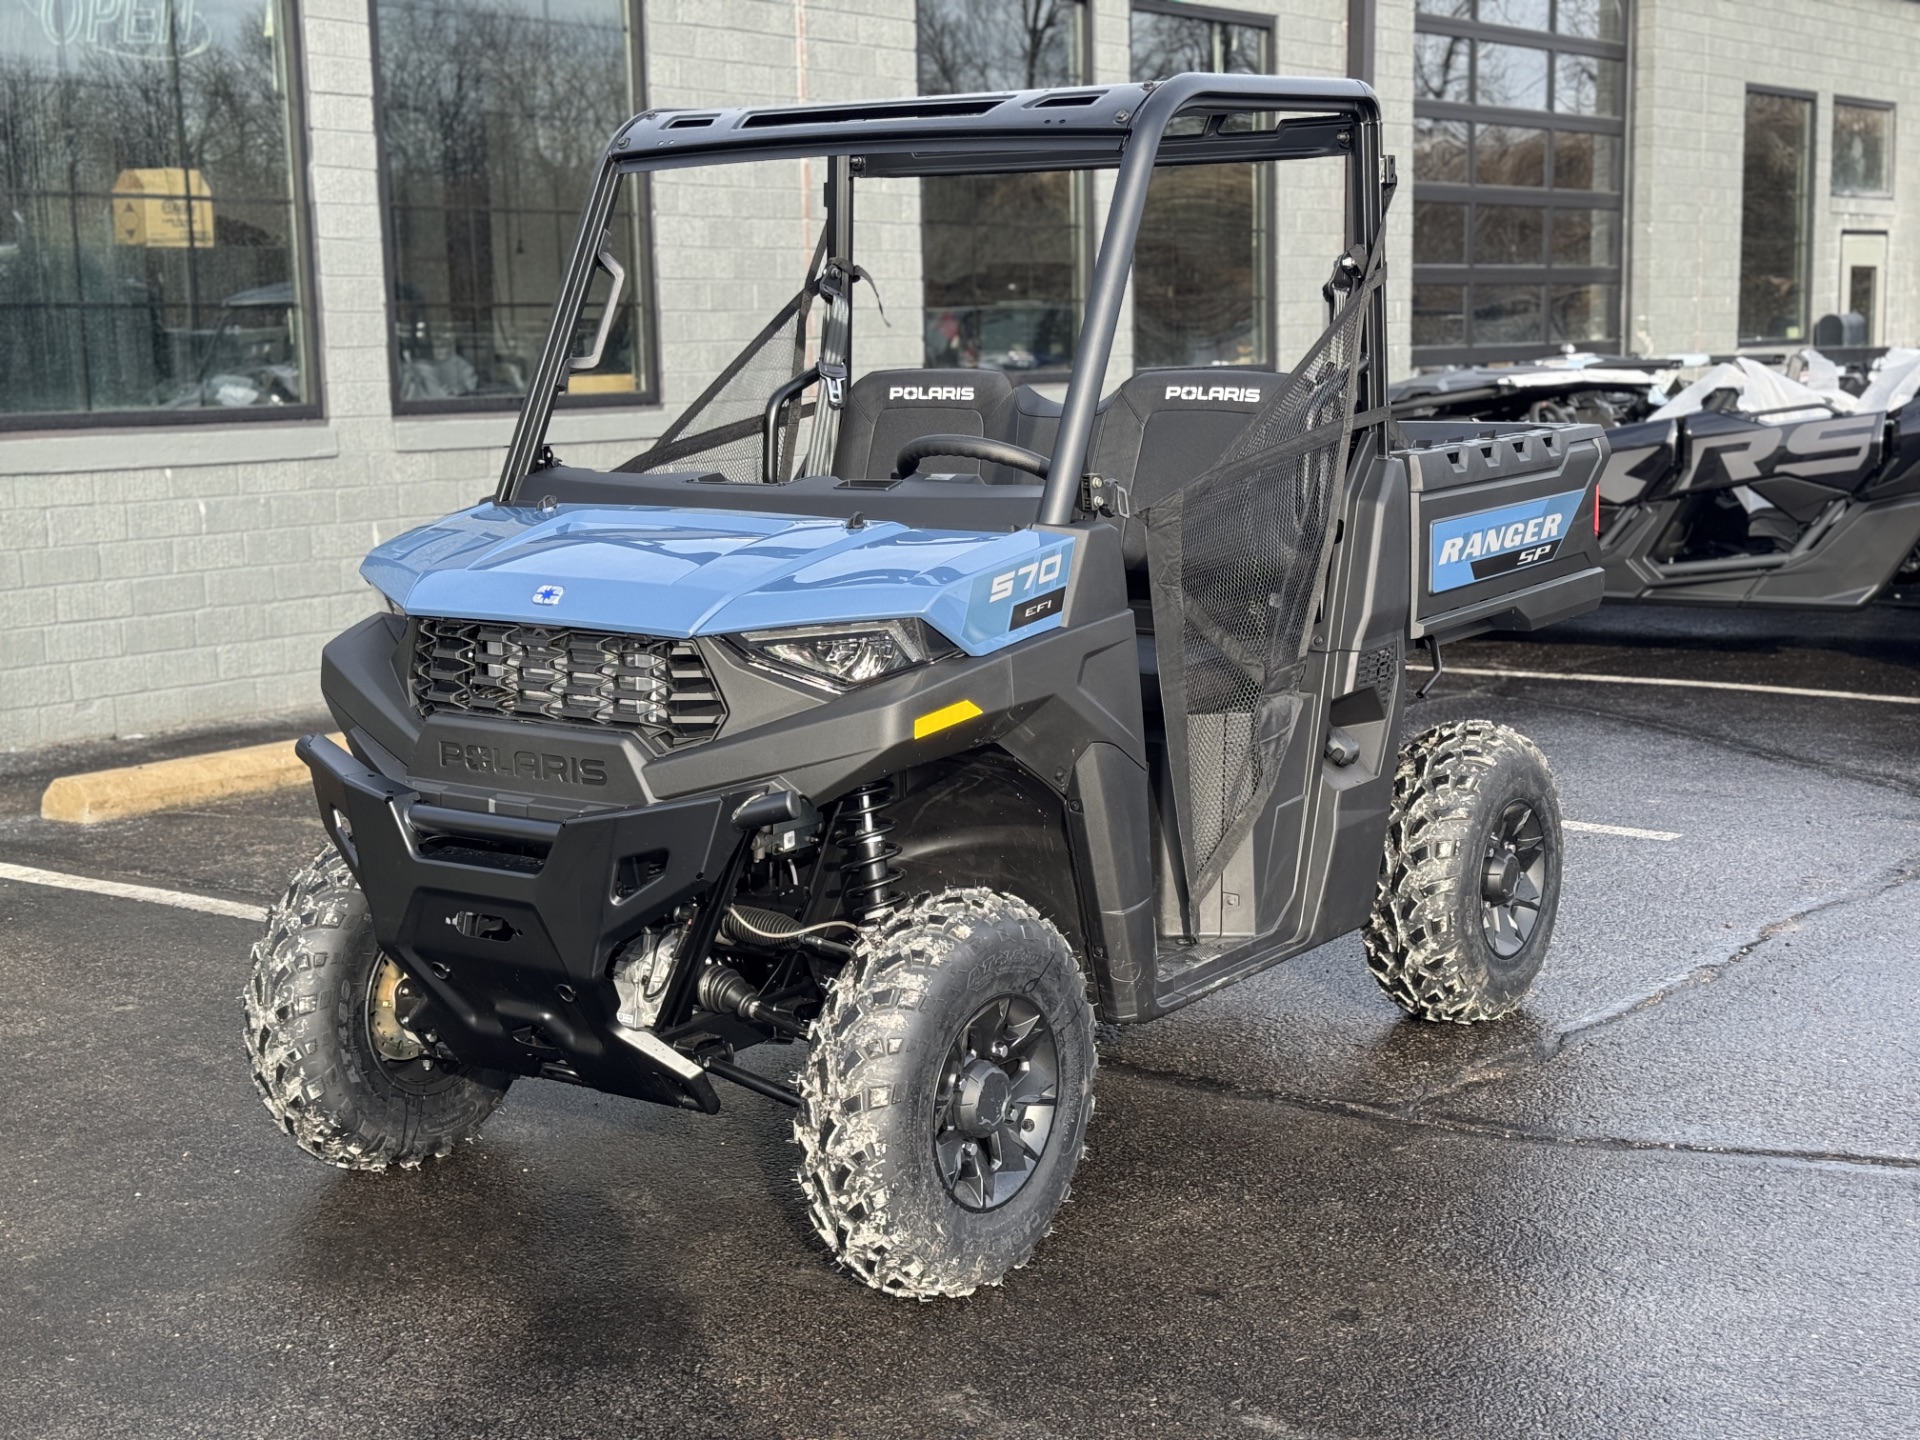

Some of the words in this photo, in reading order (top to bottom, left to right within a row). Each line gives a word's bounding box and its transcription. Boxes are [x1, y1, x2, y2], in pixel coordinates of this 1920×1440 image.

[889, 386, 975, 401] POLARIS
[1165, 386, 1260, 403] POLARIS
[1438, 513, 1563, 566] RANGER
[1516, 544, 1552, 566] SP
[989, 554, 1062, 604] 570
[1025, 600, 1052, 617] EFI
[438, 740, 608, 787] POLARIS
